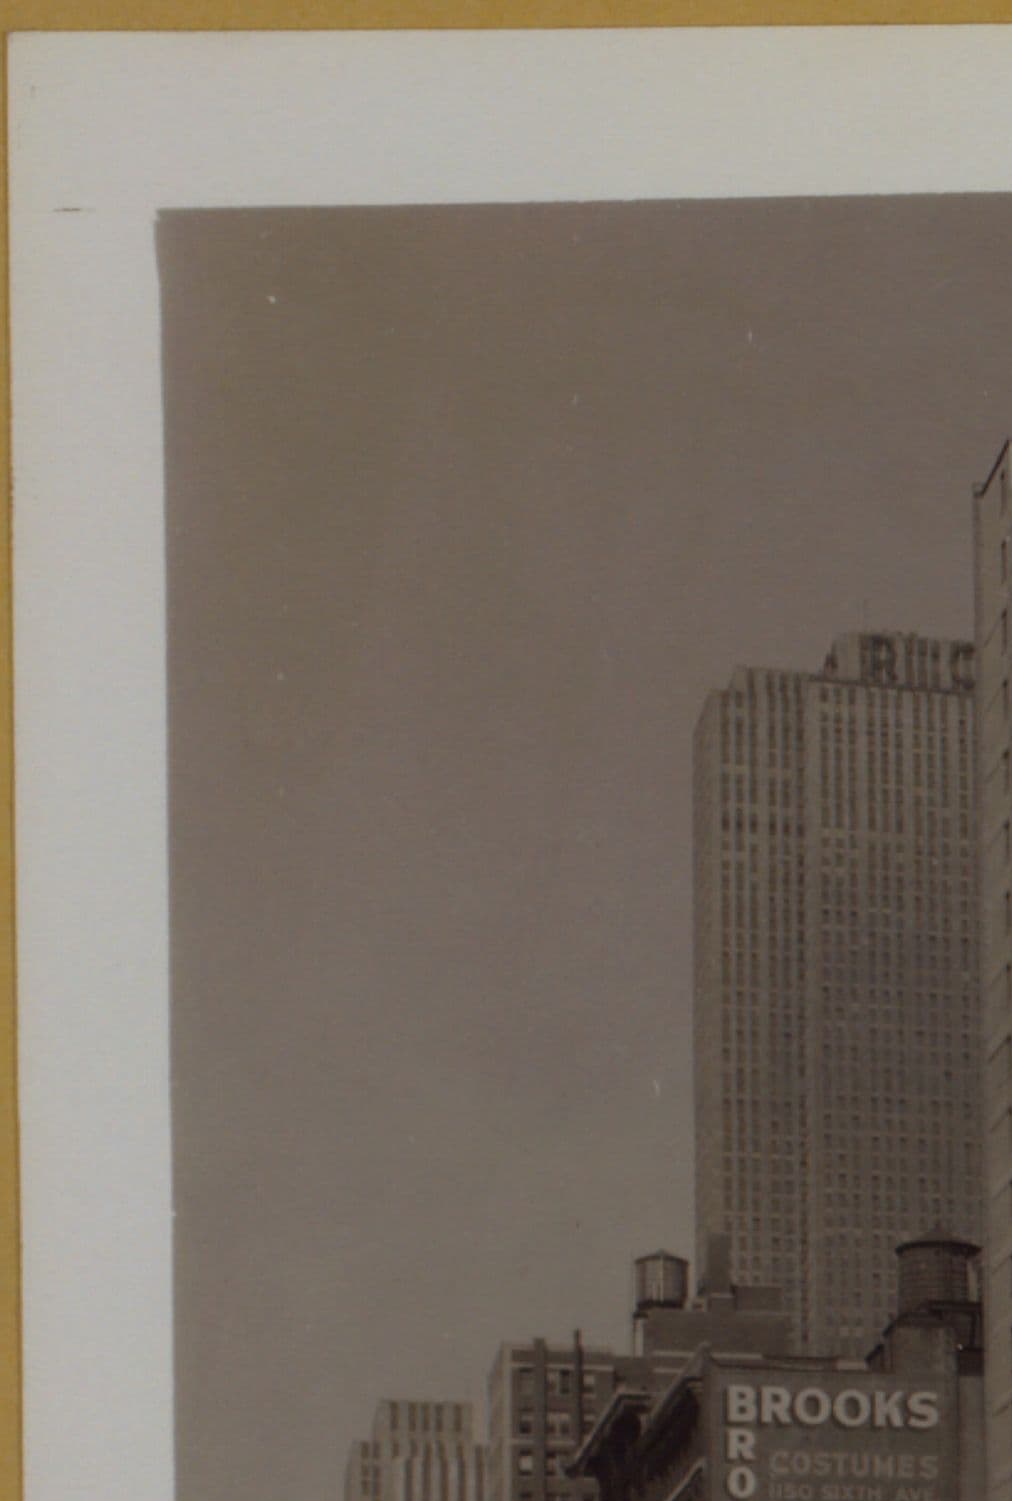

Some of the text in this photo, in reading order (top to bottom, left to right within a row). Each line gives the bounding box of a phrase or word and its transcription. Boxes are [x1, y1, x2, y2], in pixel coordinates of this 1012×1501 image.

[870, 634, 974, 688] RC
[725, 1383, 941, 1430] BROOKS
[768, 1450, 940, 1480] COSTUMES
[768, 1483, 813, 1501] 1150
